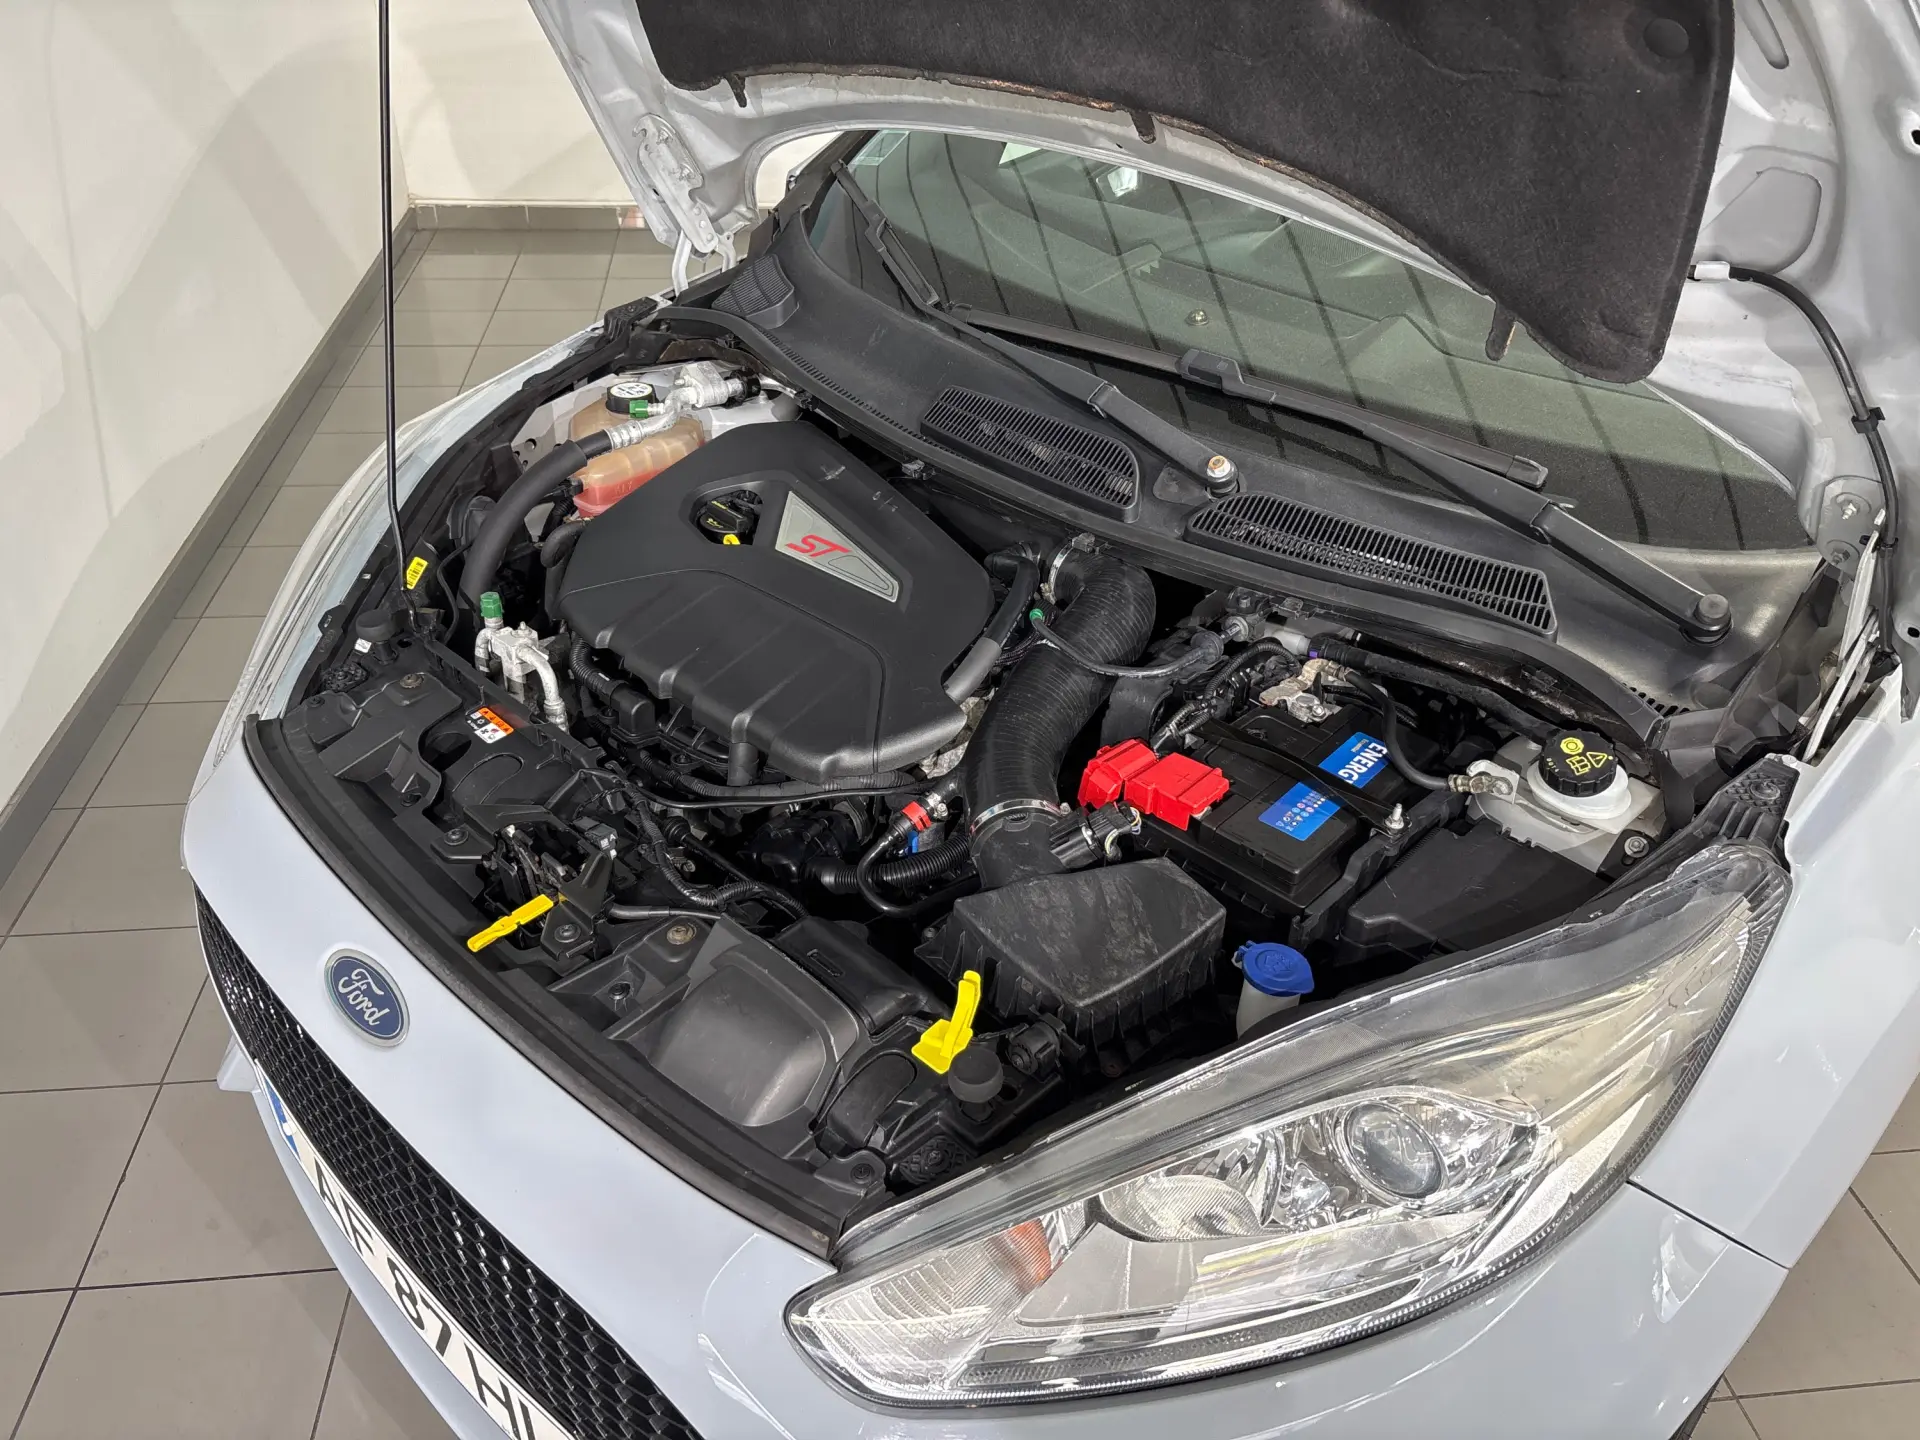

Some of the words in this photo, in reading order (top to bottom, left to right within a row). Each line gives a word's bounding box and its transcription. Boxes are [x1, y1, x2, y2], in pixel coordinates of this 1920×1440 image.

[785, 534, 852, 558] ST
[1338, 742, 1388, 784] ENERG
[338, 968, 391, 1026] Ford
[314, 1156, 377, 1257] AF
[386, 1256, 452, 1358] 87
